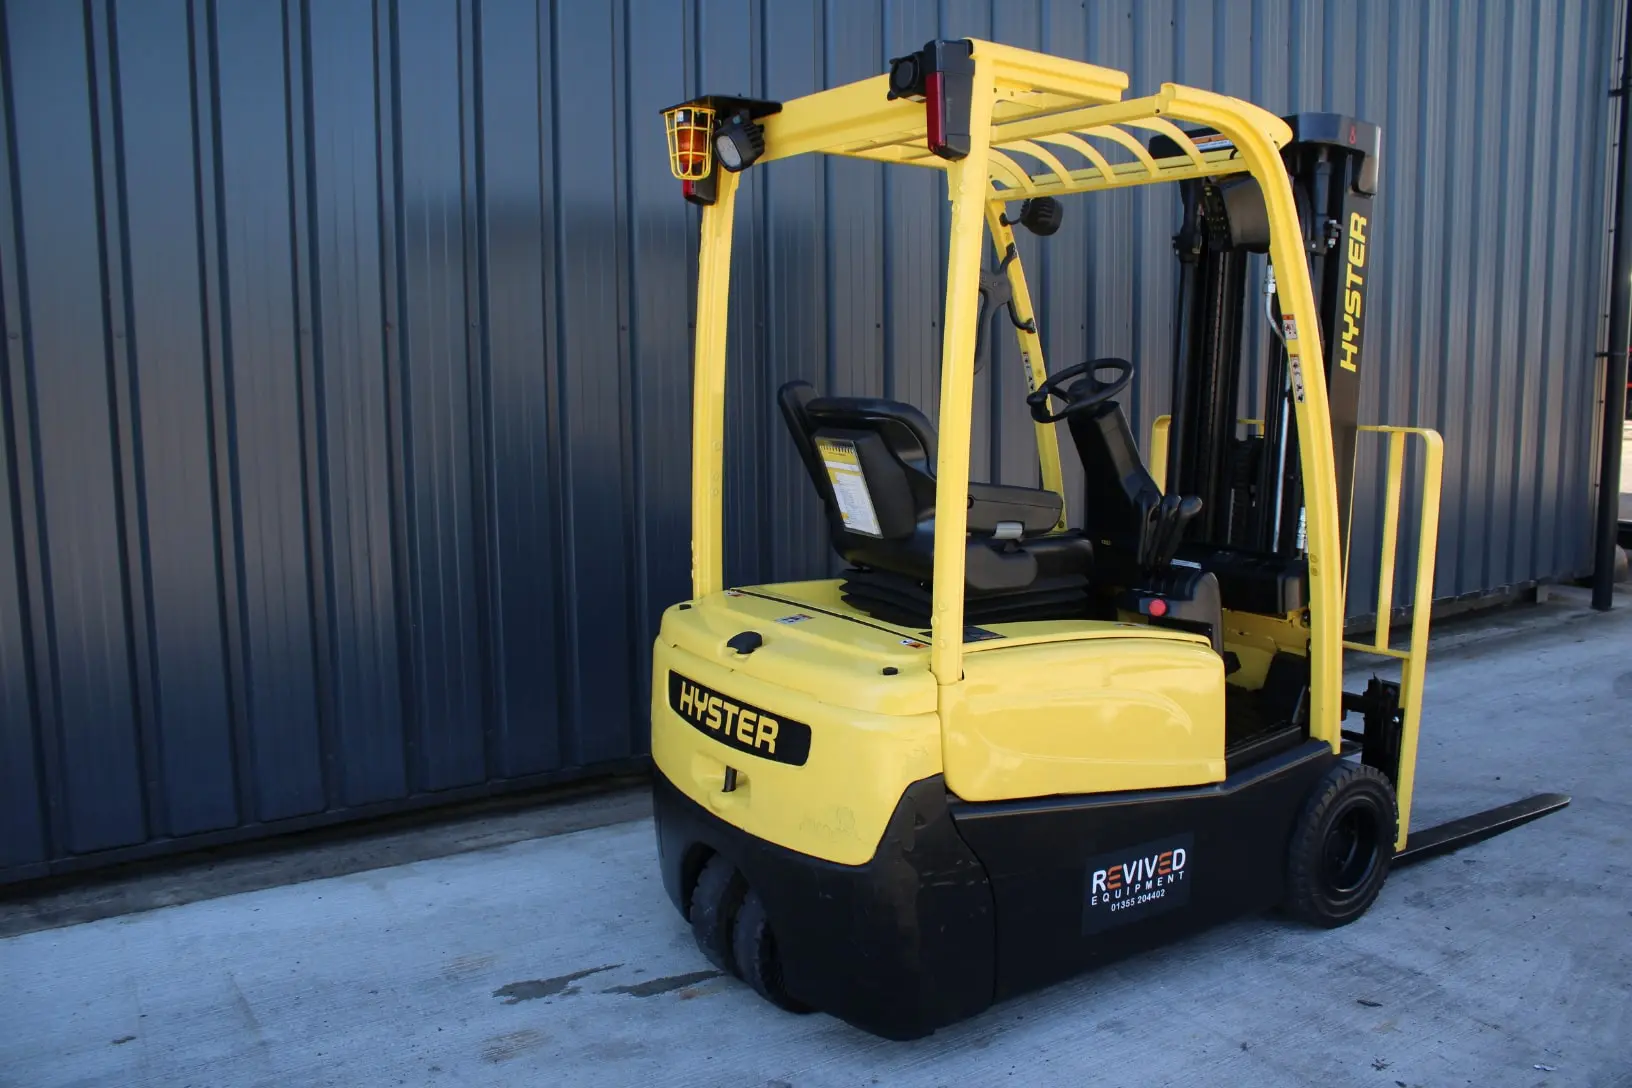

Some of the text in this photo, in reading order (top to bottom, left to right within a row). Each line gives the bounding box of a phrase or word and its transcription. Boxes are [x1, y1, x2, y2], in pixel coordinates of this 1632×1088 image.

[1340, 212, 1368, 373] HYSTER
[680, 681, 779, 754] HYSTER
[1091, 871, 1185, 906] EQUIPMENT
[1092, 848, 1186, 894] REVIVED
[1111, 889, 1165, 912] 01355 204402
